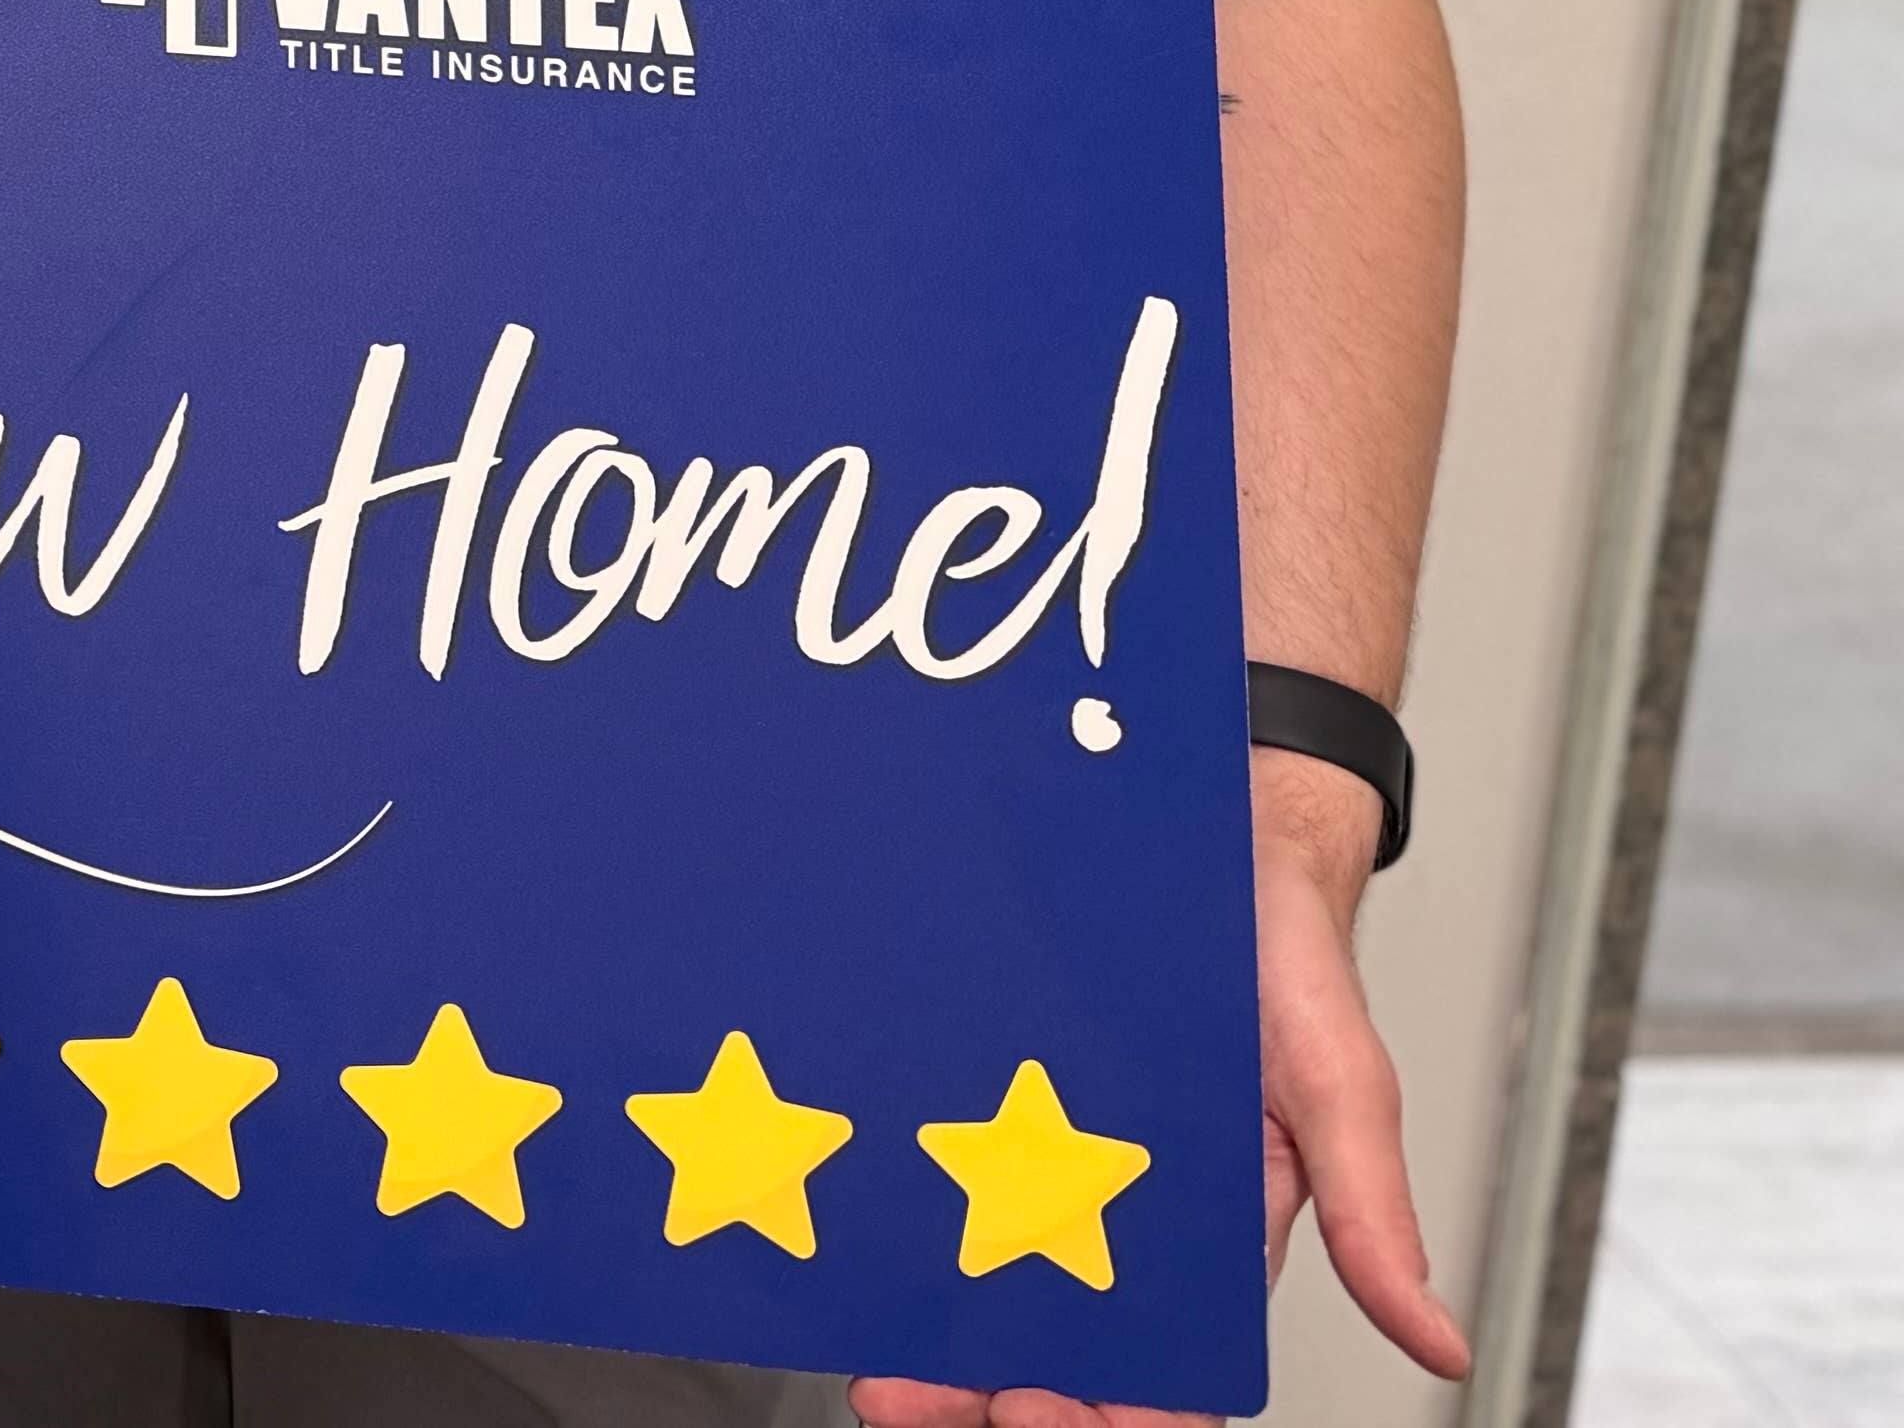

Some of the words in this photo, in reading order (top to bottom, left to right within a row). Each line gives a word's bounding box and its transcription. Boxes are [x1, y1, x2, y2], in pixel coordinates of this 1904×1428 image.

[279, 38, 405, 77] TITLE
[431, 50, 697, 97] INSURANCE
[277, 295, 1178, 753] Home!
